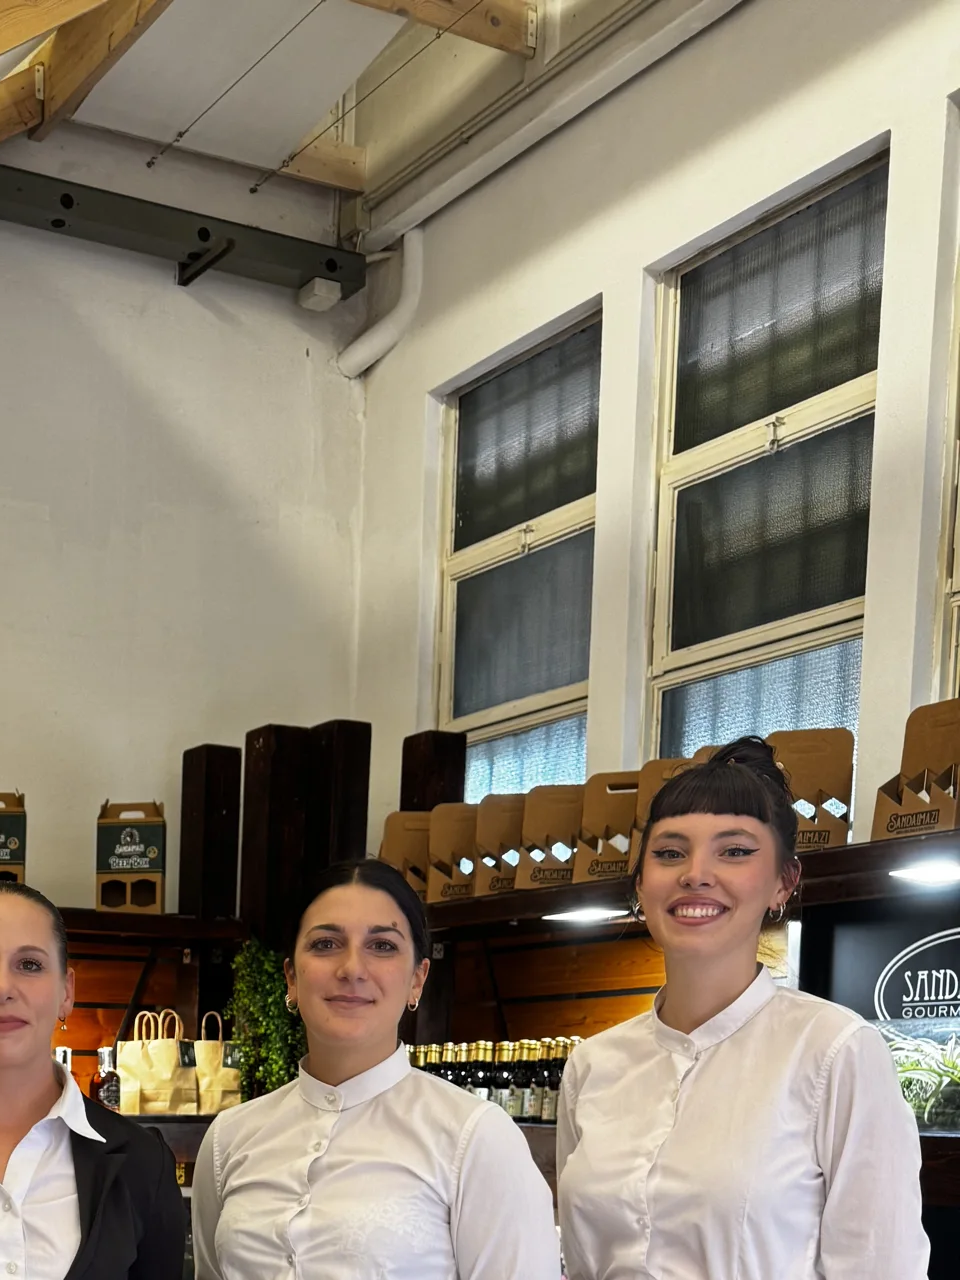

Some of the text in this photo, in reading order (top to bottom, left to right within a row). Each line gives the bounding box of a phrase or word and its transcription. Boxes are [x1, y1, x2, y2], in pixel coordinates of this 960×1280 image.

[887, 809, 941, 833] SANDALMAZI
[109, 855, 150, 869] BEER BOX
[902, 969, 960, 1002] SAND
